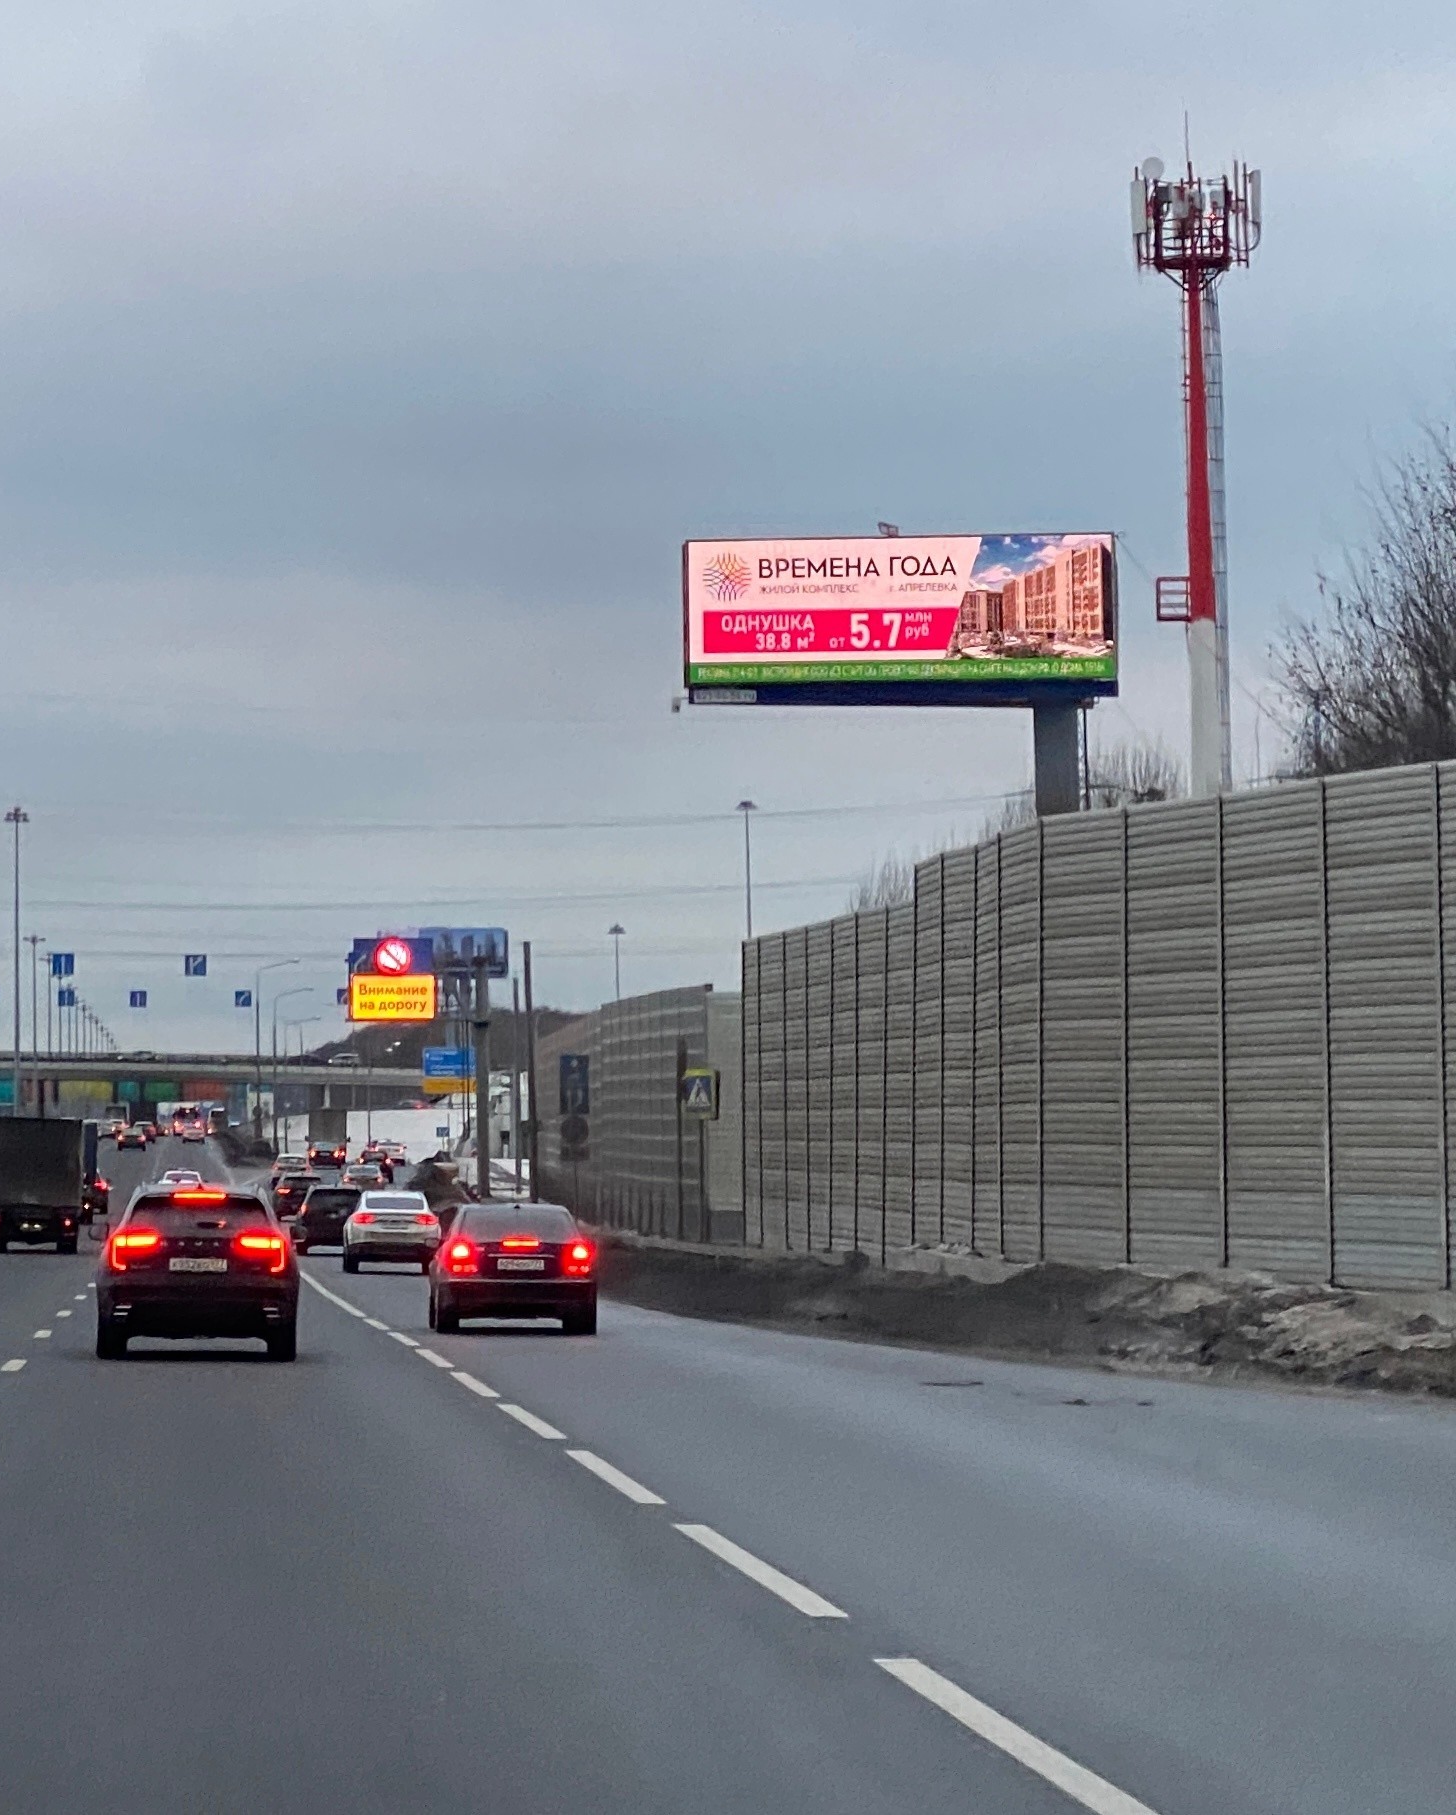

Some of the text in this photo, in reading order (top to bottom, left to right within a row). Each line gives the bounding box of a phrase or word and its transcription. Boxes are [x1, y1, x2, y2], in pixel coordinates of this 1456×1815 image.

[758, 555, 957, 579] ВРЕМЕНА ГОДА
[759, 583, 800, 594] ЖИЛОЙ
[802, 583, 859, 594] КОМПЛЕКС
[898, 582, 958, 593] АПРЕЛЕВКА
[721, 614, 815, 634] ОДНУШКА
[905, 611, 932, 623] млн
[829, 612, 902, 649] от 5.7
[905, 624, 930, 640] руб
[755, 633, 791, 650] 38.8
[359, 984, 427, 996] Внимание
[359, 1001, 427, 1012] на дорогу
